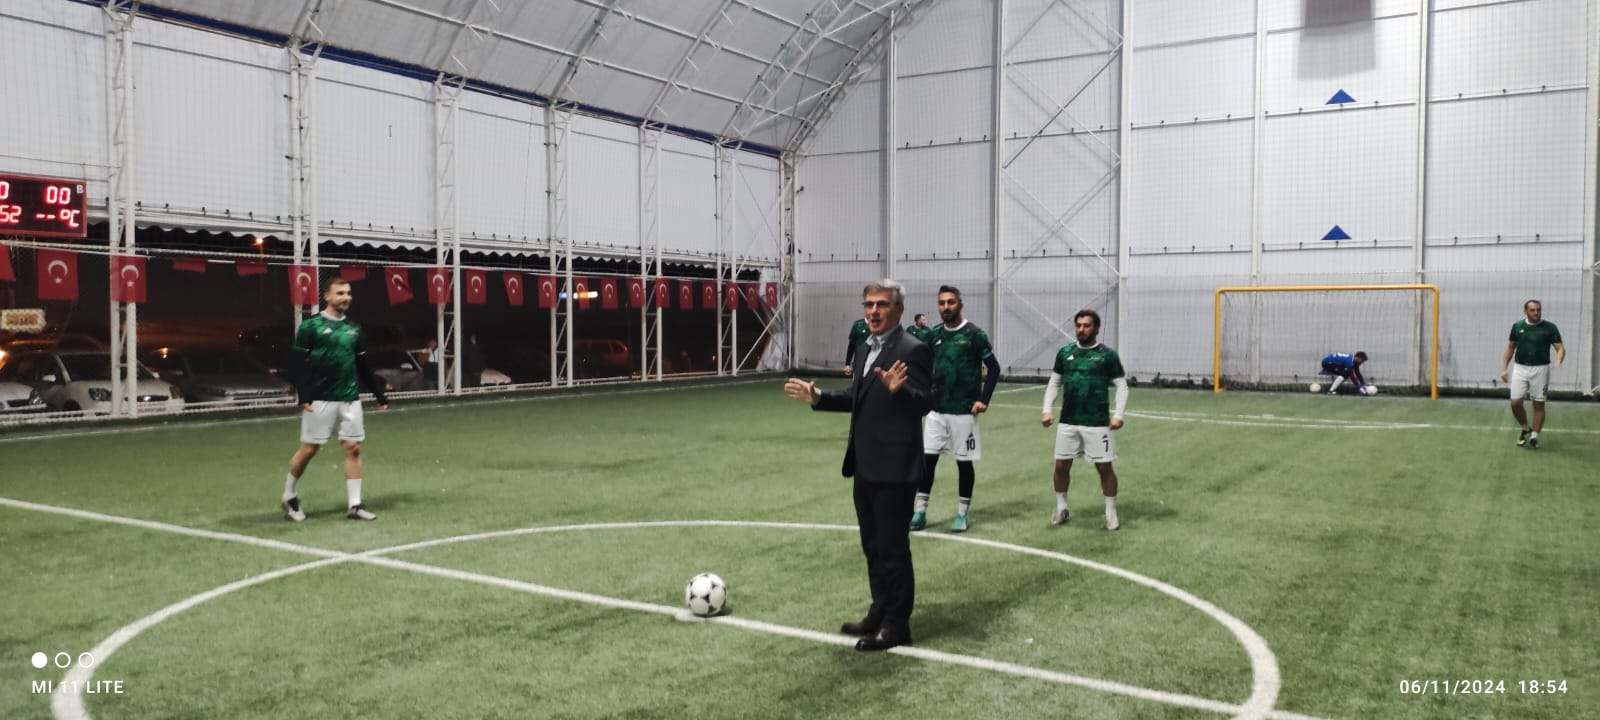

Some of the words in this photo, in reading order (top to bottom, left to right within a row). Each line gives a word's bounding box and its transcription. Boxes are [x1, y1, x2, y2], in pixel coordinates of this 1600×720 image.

[46, 186, 71, 204] 00
[76, 184, 84, 194] B
[966, 438, 976, 450] 10
[1103, 439, 1109, 452] 7
